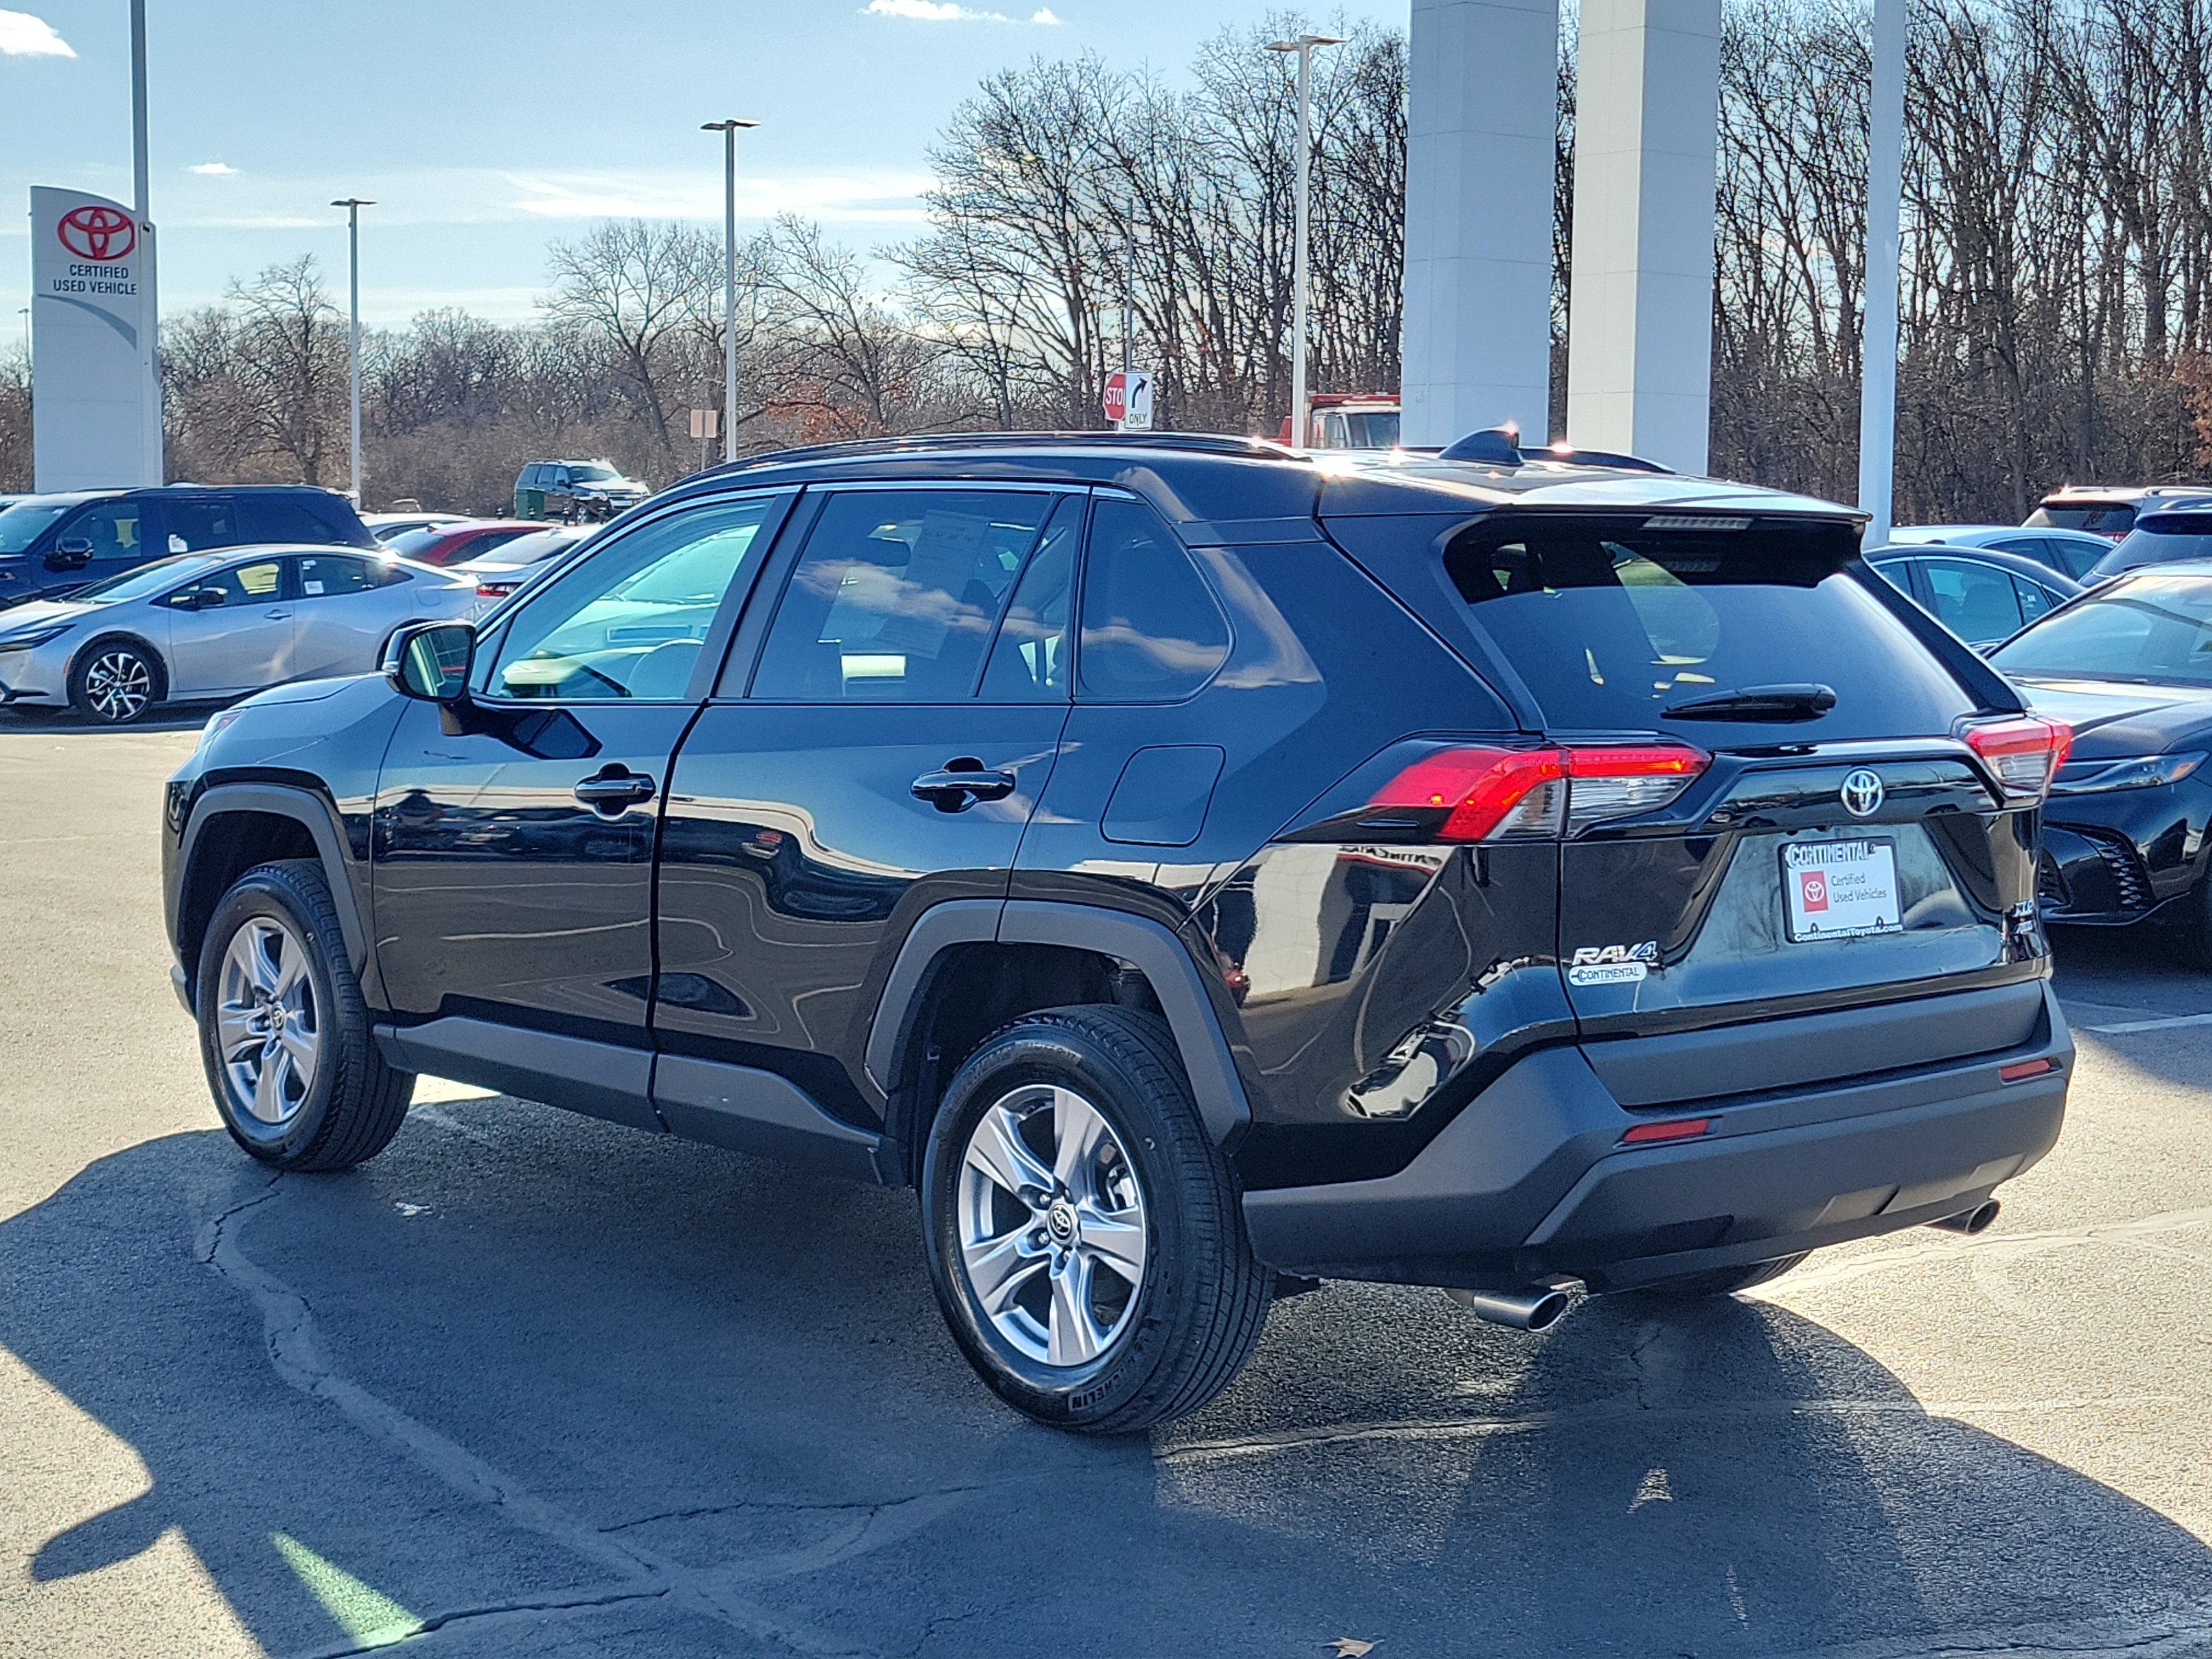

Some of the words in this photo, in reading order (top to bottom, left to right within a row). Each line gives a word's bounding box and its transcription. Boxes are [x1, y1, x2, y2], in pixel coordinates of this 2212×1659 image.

[70, 264, 129, 279] CERTIFIED
[53, 279, 86, 292] USED
[89, 281, 137, 295] VEHICLE
[1105, 387, 1125, 405] STO
[1129, 413, 1148, 426] ONLY
[1785, 841, 1870, 868] CONTINENTAL
[1831, 872, 1865, 887] Certified
[1833, 890, 1854, 903] Used
[1854, 888, 1887, 901] Vehicles
[1794, 924, 1903, 942] ContinentalToyota.com
[1571, 940, 1658, 966] RAV4
[1577, 967, 1640, 983] CONTINENTAL
